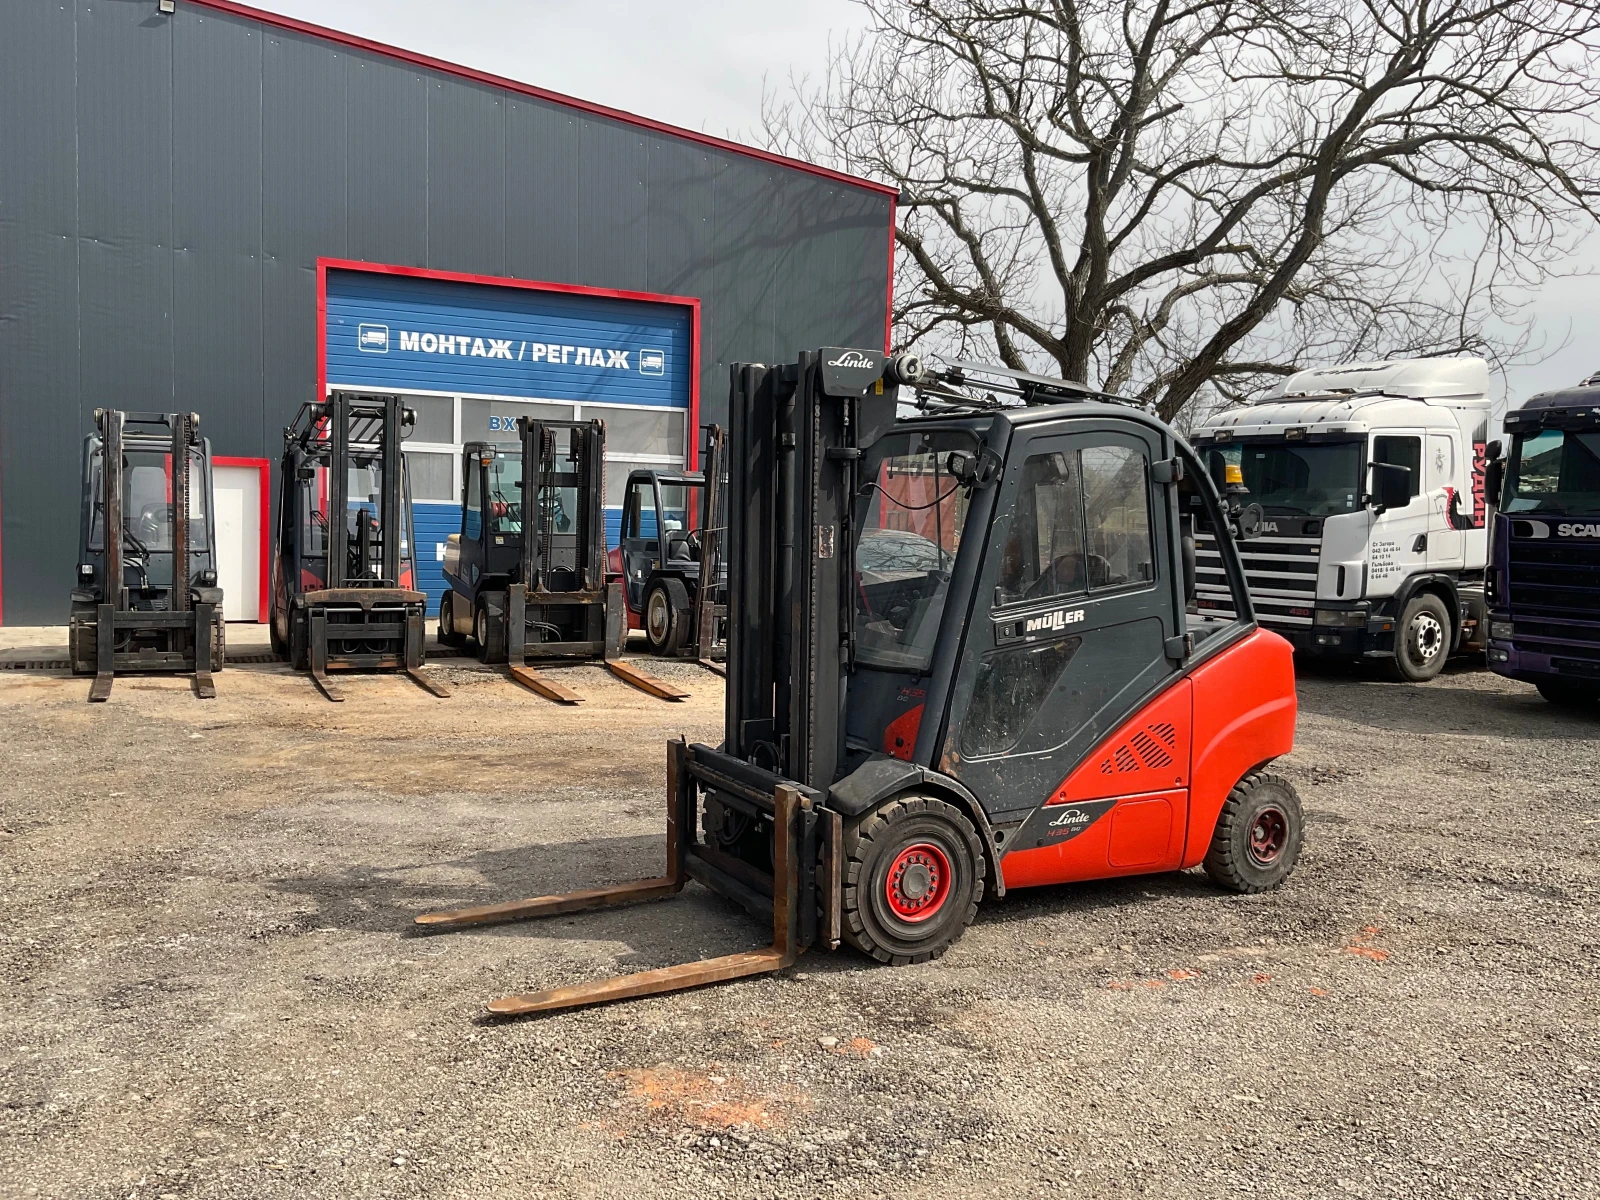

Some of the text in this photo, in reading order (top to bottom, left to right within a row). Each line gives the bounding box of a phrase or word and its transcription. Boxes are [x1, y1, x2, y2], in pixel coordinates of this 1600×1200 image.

[399, 331, 630, 370] МОНТАЖ / РЕГЛАЖ
[827, 351, 874, 369] Linde
[489, 415, 519, 432] ВХ
[1472, 442, 1487, 528] РУДИН
[1026, 609, 1085, 632] MÜLLER
[1289, 608, 1310, 616] 420
[1048, 809, 1090, 826] Linde
